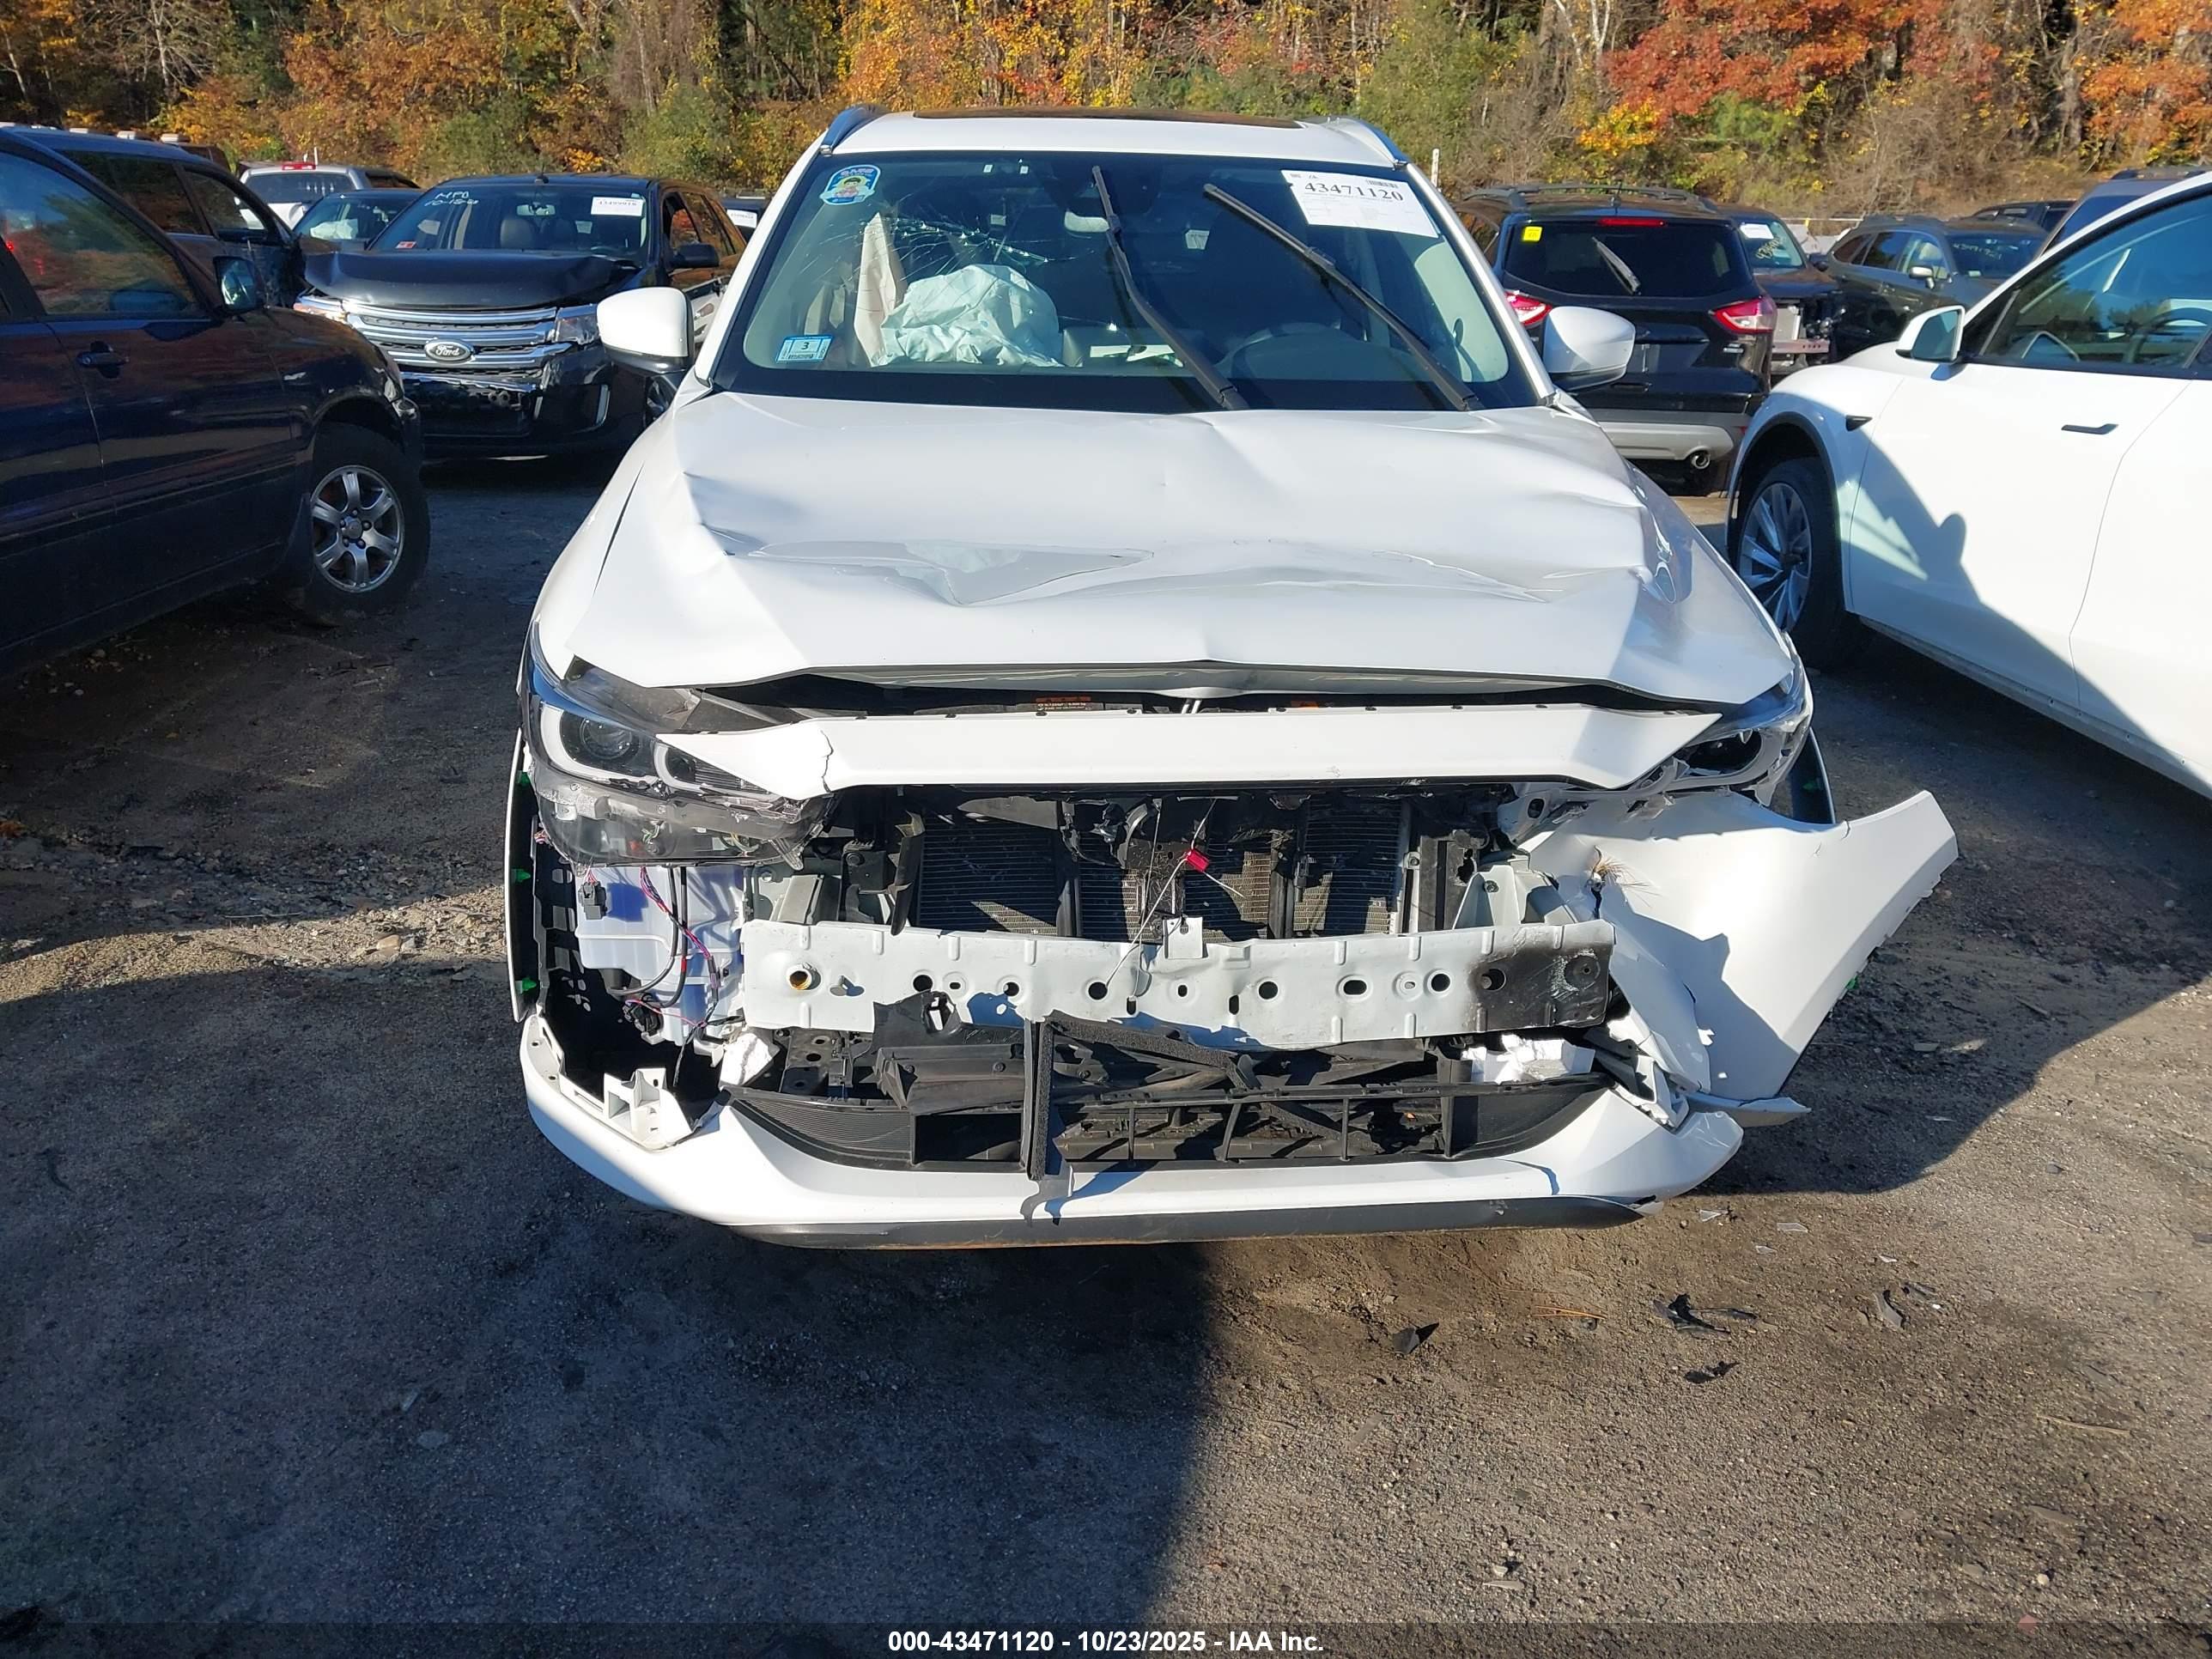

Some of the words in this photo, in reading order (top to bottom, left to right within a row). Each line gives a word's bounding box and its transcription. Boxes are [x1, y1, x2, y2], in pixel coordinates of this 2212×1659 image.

[1304, 182, 1403, 202] 43471120
[435, 344, 460, 356] Ford
[800, 342, 810, 350] 3
